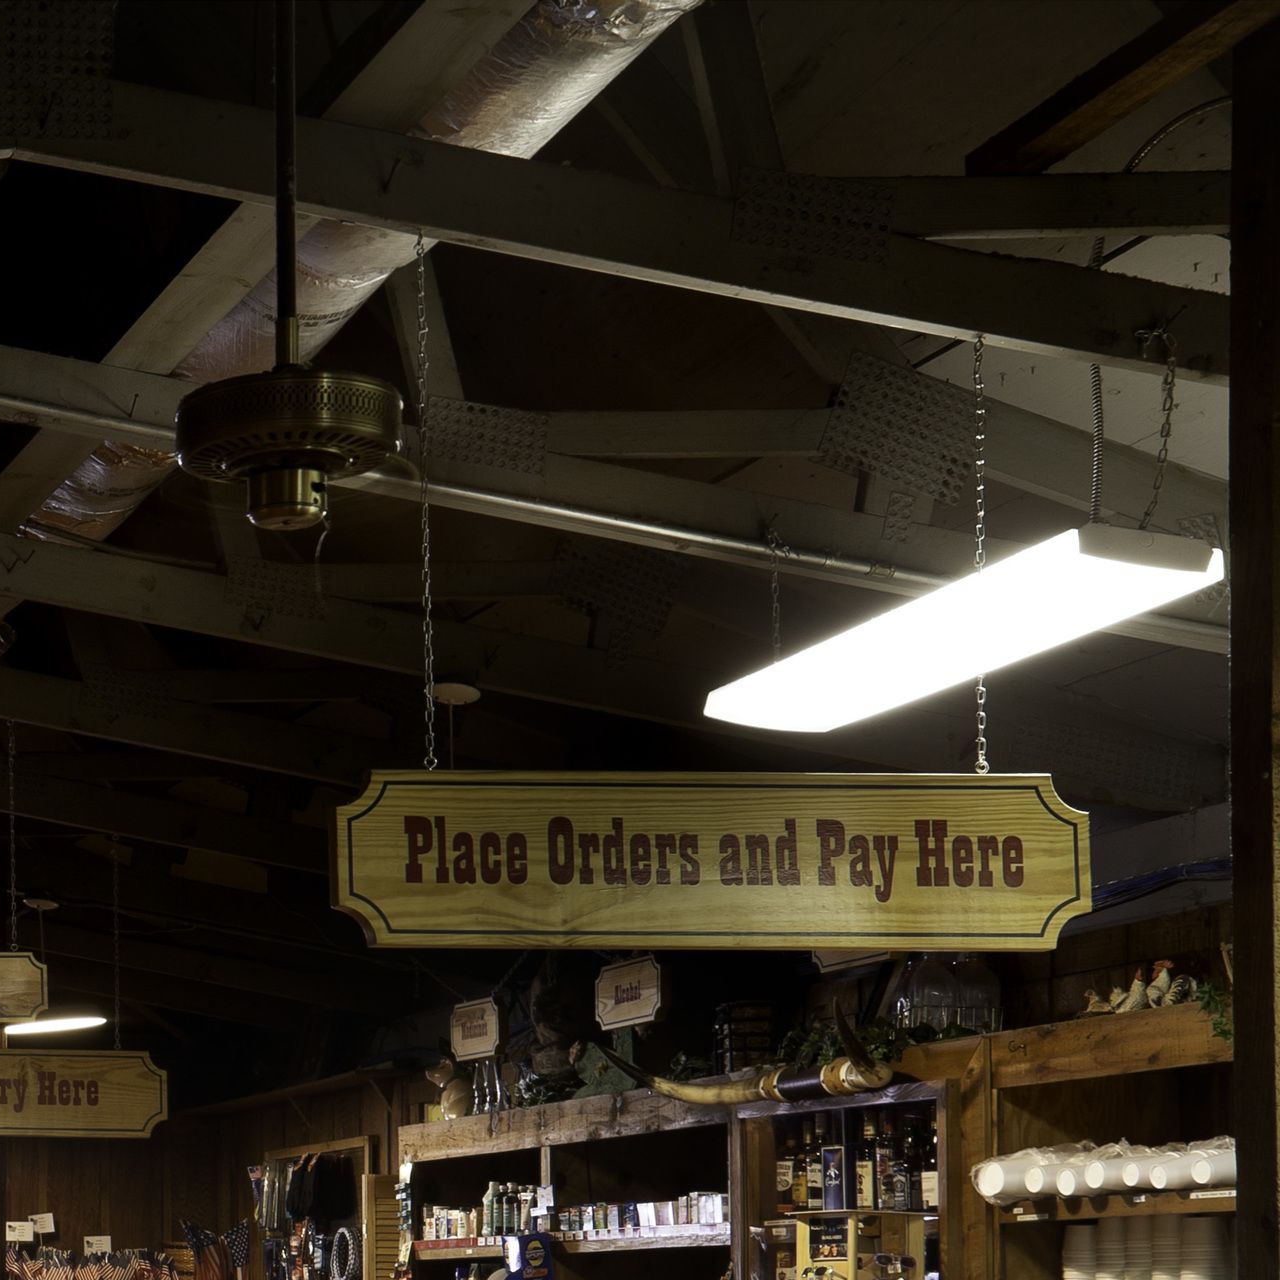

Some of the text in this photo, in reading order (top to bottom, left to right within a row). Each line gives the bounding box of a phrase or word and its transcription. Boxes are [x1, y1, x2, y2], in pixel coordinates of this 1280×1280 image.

[403, 814, 1025, 903] Place Orders and Pay Here
[36, 1070, 100, 1106] Here
